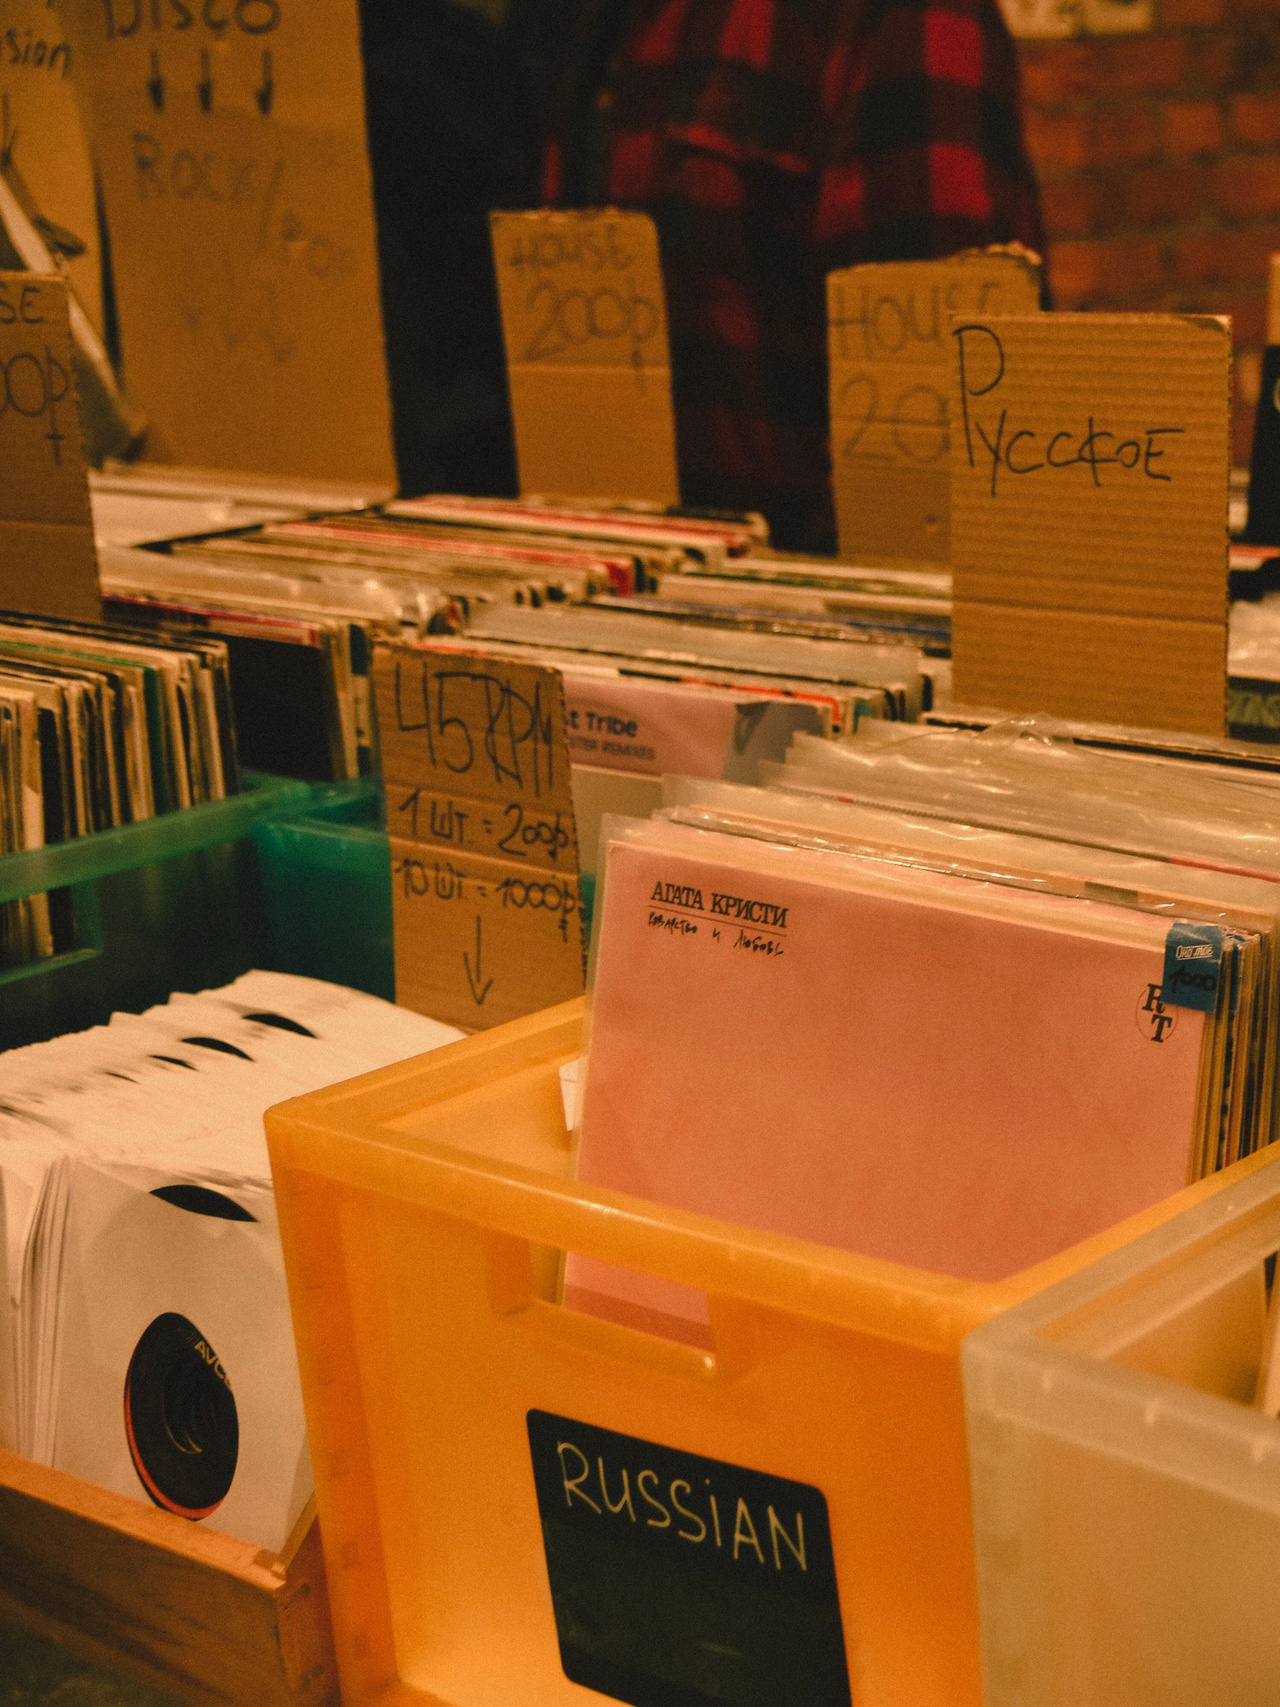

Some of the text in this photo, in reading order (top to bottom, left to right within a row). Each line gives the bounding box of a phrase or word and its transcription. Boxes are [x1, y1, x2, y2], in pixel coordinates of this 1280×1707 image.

[585, 711, 639, 738] Tribe
[395, 858, 431, 898] 10
[650, 881, 790, 928] АГАТА КРИСТИ
[1150, 1013, 1173, 1043] T
